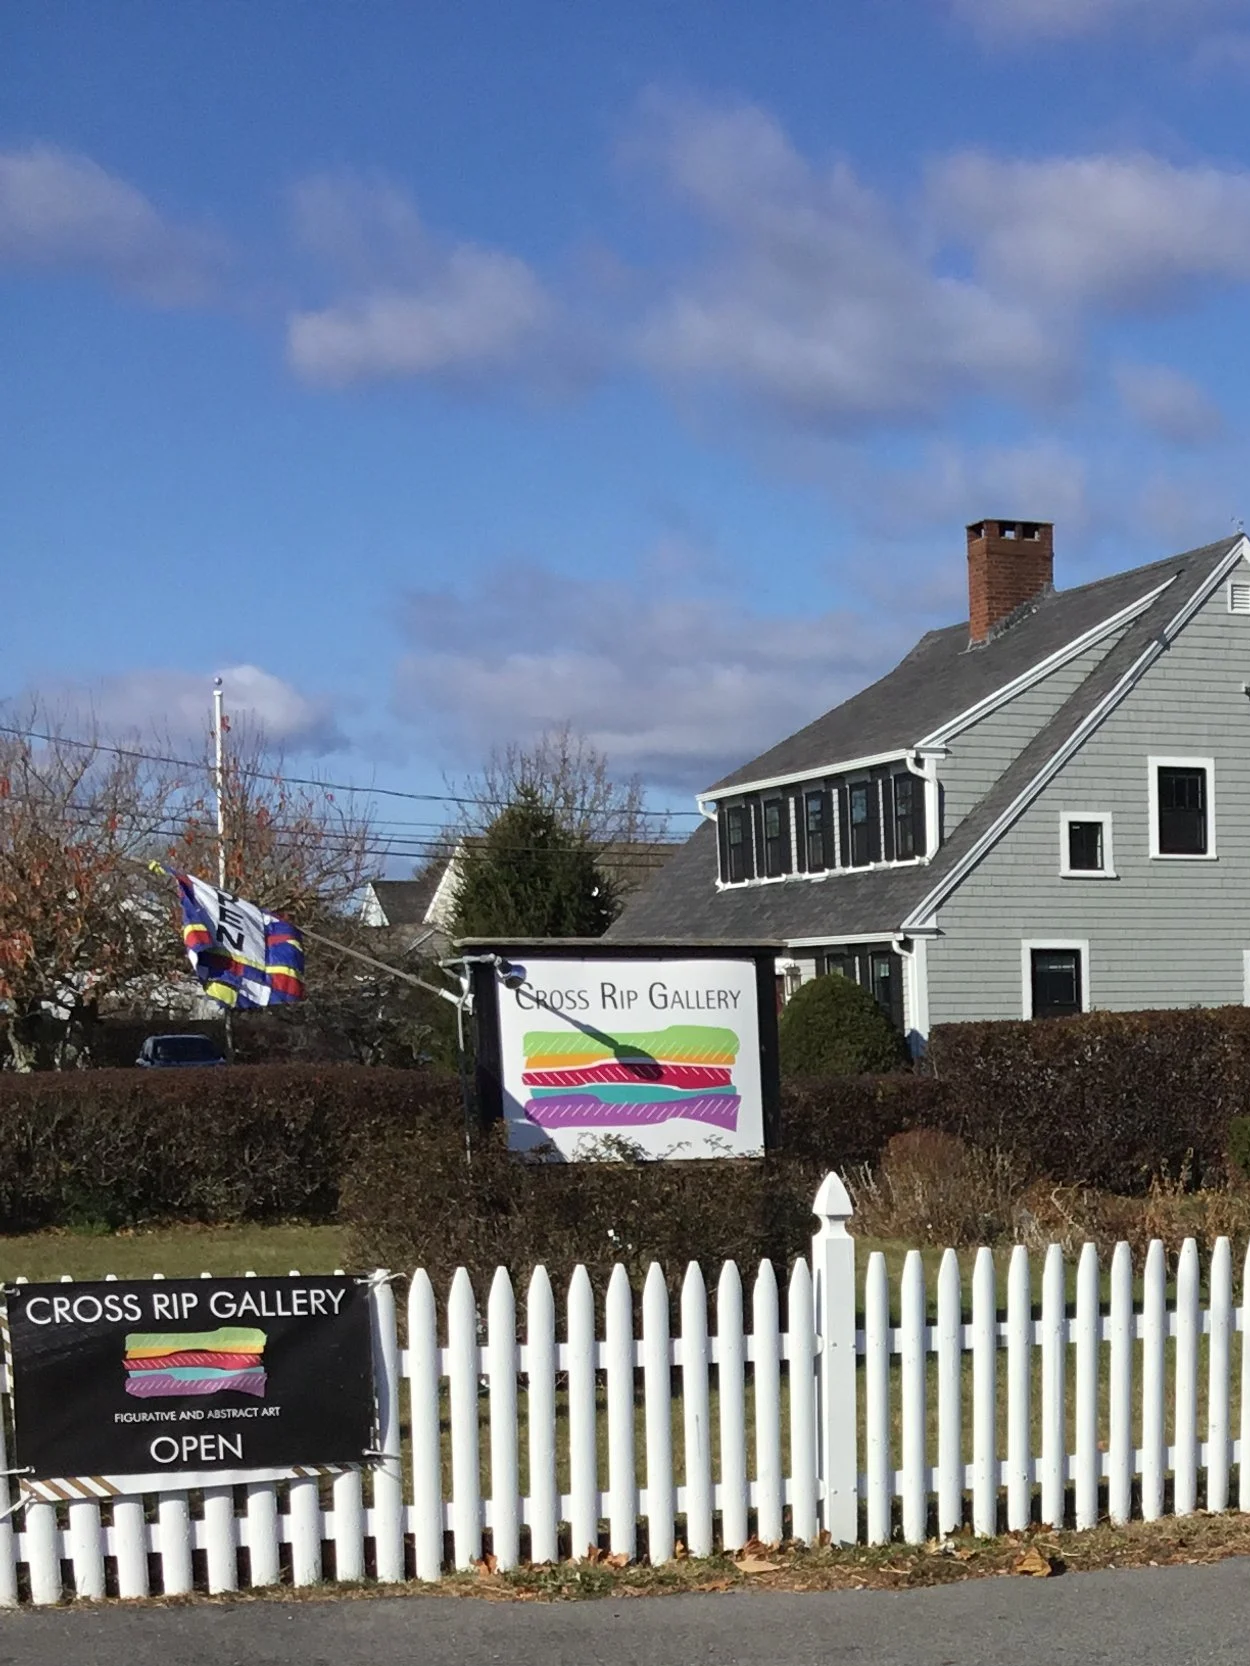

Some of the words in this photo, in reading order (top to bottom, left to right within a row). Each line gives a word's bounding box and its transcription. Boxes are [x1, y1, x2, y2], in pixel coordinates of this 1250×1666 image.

[215, 888, 245, 952] PEN
[515, 982, 590, 1010] CROSS
[600, 982, 638, 1010] RIP
[649, 981, 742, 1010] GALLERY
[25, 1294, 143, 1325] CROSS
[153, 1292, 199, 1320] RIP
[209, 1288, 347, 1319] GALLERY
[114, 1410, 177, 1423] FIGURATIVE
[179, 1410, 205, 1421] AND
[207, 1407, 260, 1420] ABSTRACT
[261, 1406, 281, 1417] ART
[150, 1433, 244, 1464] OPEN
